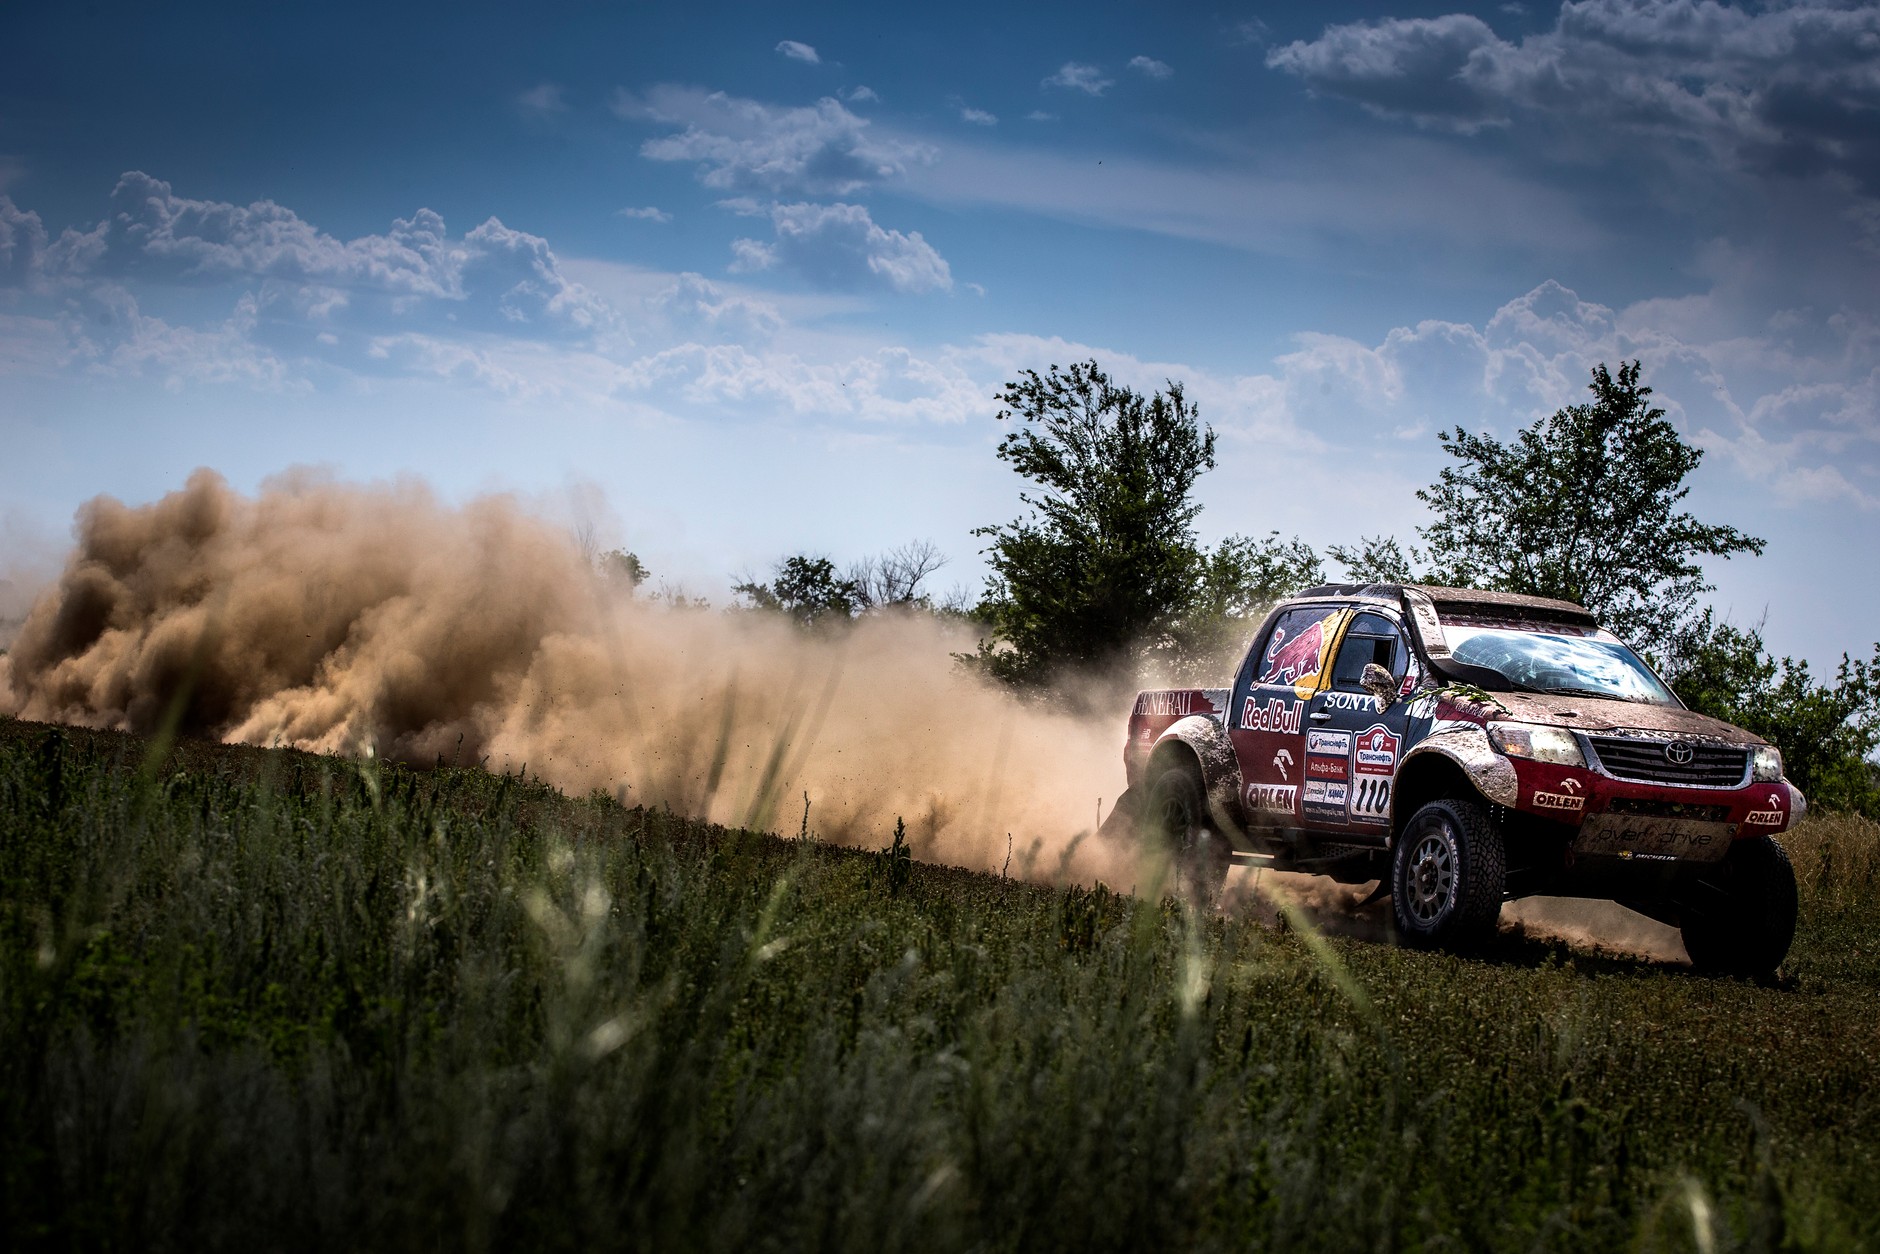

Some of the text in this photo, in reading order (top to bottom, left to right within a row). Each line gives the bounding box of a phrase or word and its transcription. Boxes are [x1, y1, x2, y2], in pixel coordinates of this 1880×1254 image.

[1134, 691, 1193, 716] GENERALI
[1323, 693, 1375, 711] SONY
[1240, 696, 1304, 734] Red Bull
[1360, 751, 1392, 764] Транснефть
[1310, 761, 1344, 774] Альфа-Банк
[1248, 787, 1294, 810] ORLEN
[1356, 778, 1390, 814] 110
[1536, 793, 1581, 808] ORLEN
[1749, 812, 1782, 823] ORLEN
[1598, 827, 1712, 846] over drive
[1634, 852, 1679, 862] MICHELIN
